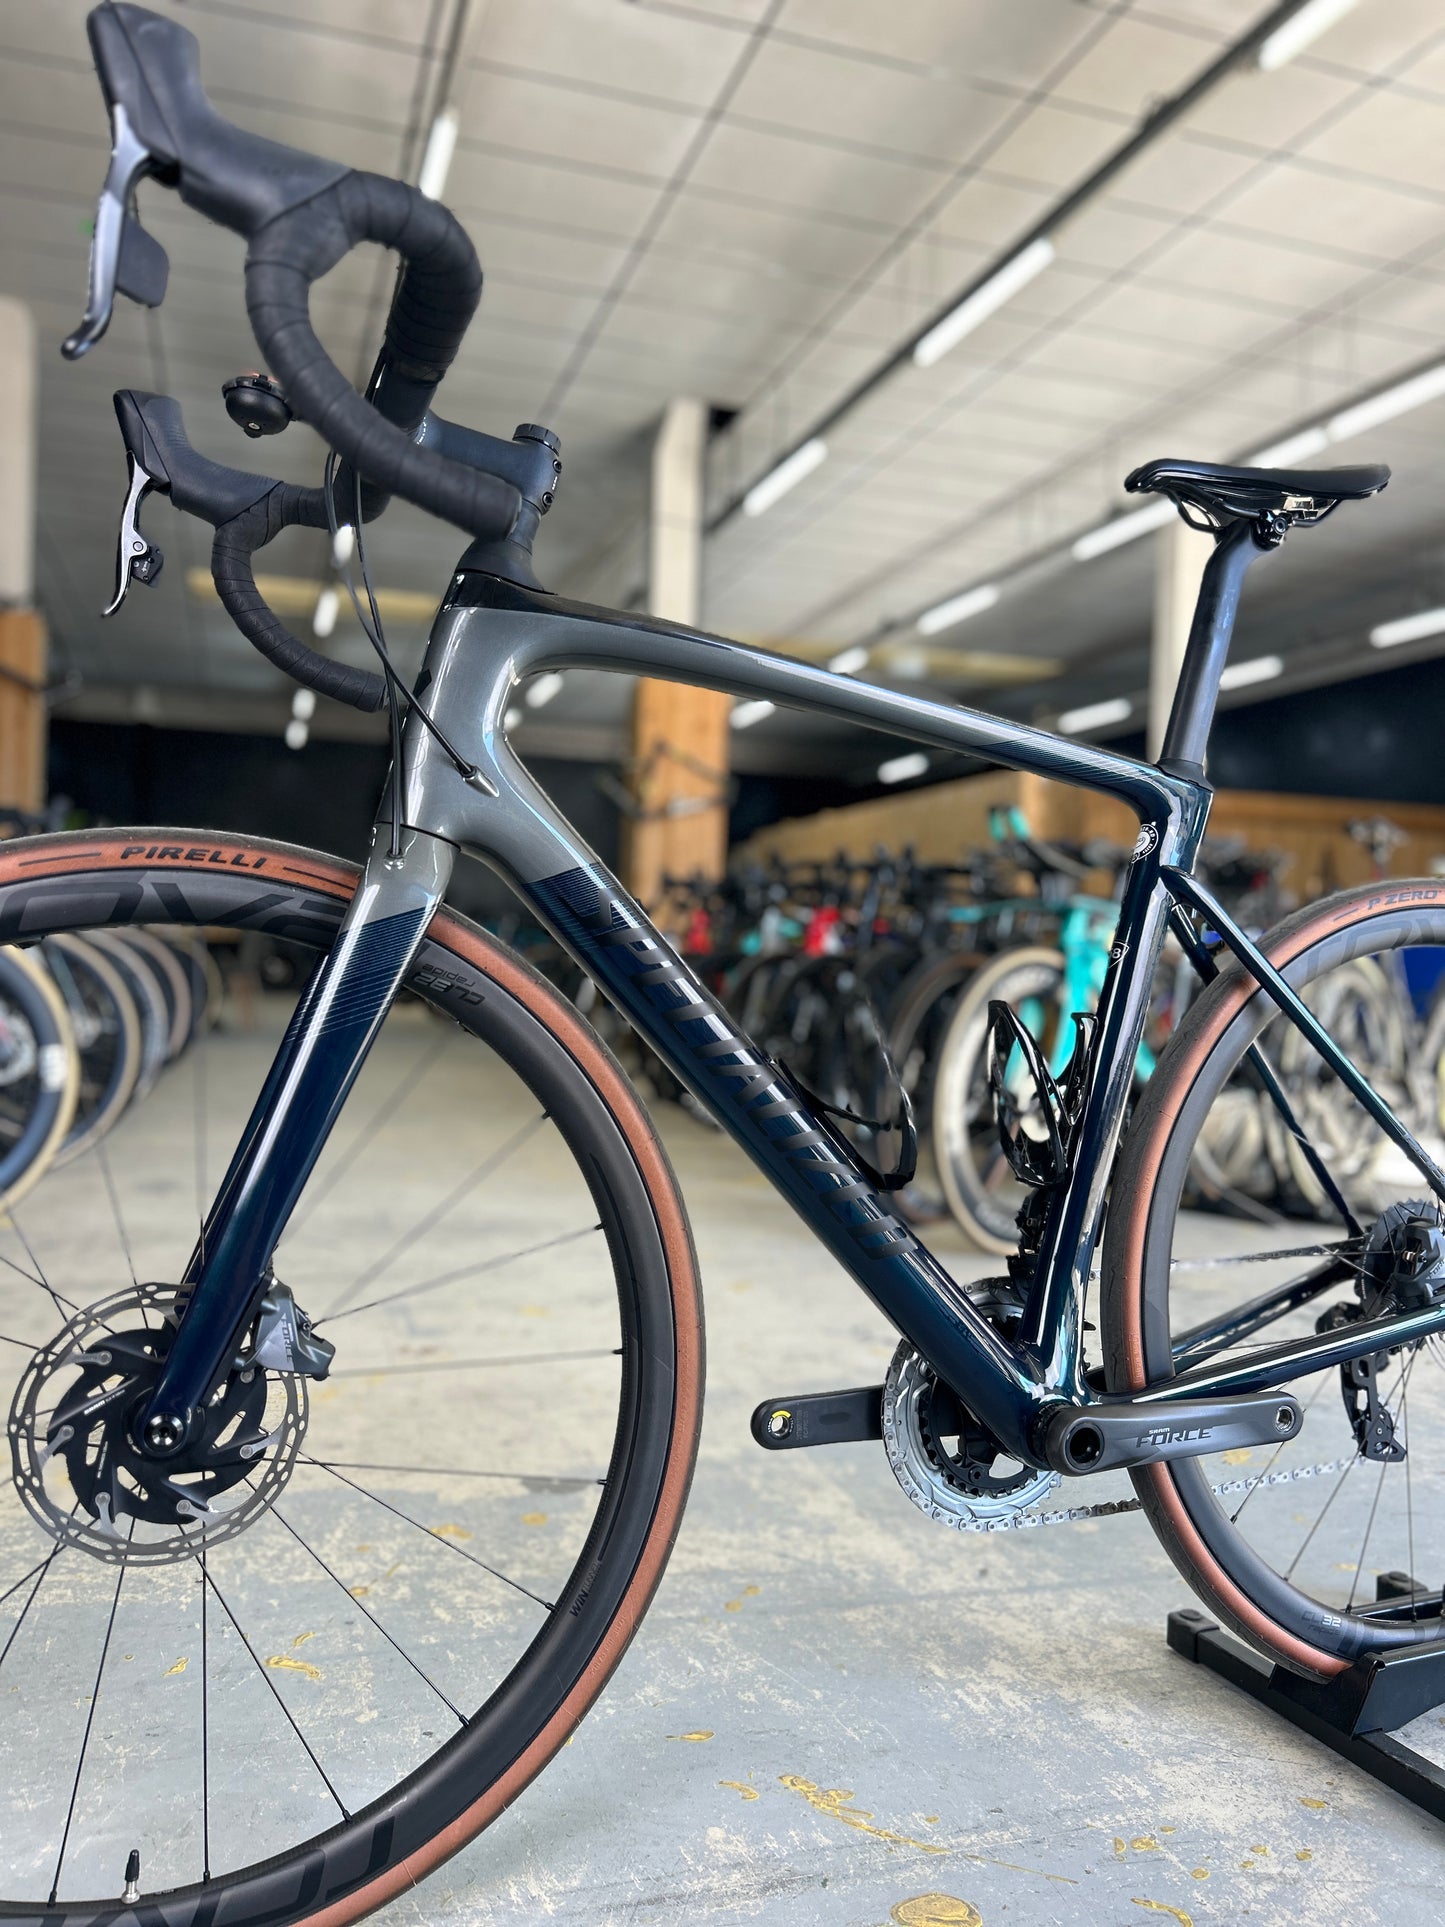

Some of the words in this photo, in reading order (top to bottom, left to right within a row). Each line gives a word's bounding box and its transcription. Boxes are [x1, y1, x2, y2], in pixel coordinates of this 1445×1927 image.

[120, 846, 268, 869] PIRELLI
[1367, 897, 1381, 910] P
[1384, 890, 1438, 905] ZERO
[422, 963, 476, 988] rapide
[413, 972, 486, 1006] CL32
[558, 886, 919, 1260] SPECIALIZED
[281, 1320, 293, 1361] FORCE
[1136, 1427, 1212, 1448] FORCE
[1149, 1427, 1170, 1435] SRAM
[1302, 1610, 1342, 1627] CL32
